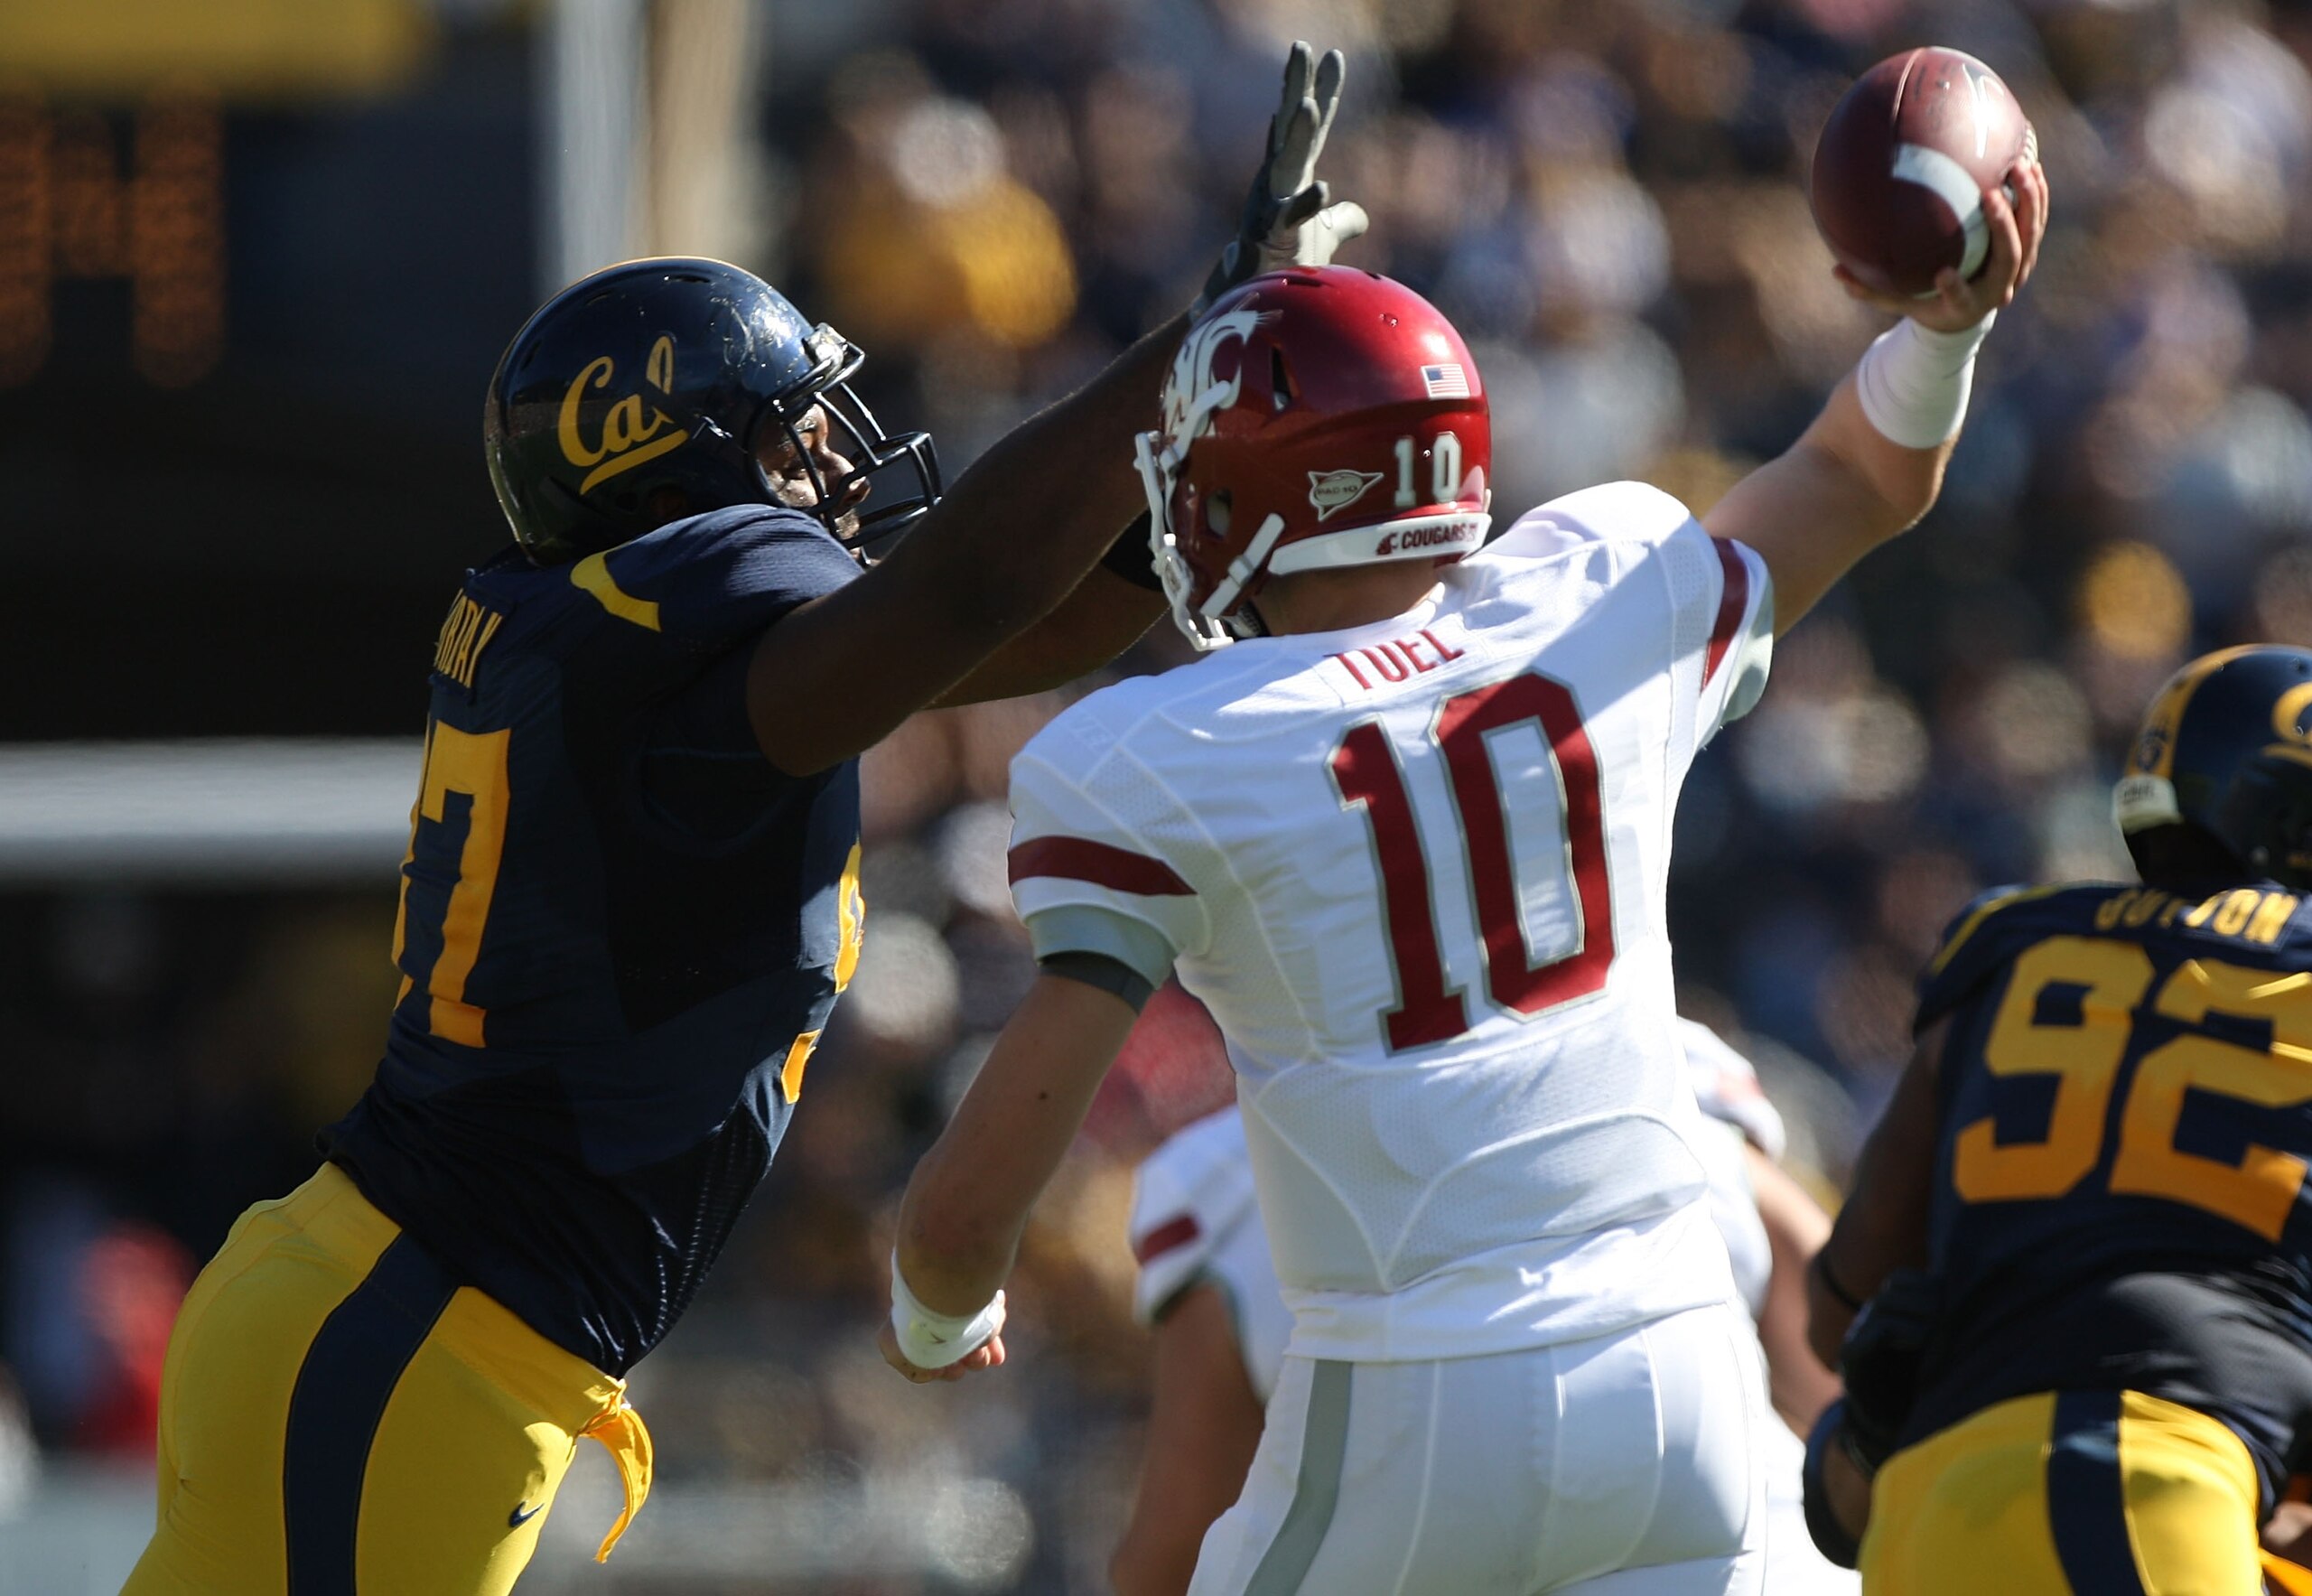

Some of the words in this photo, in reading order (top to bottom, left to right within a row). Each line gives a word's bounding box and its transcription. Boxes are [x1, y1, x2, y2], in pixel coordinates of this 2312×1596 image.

[558, 336, 689, 495] Cal
[1395, 431, 1461, 506] 10
[1402, 523, 1465, 550] COUGARS
[1323, 629, 1466, 690] TUEL
[1324, 667, 1620, 1059] 10
[1953, 934, 2312, 1243] 92
